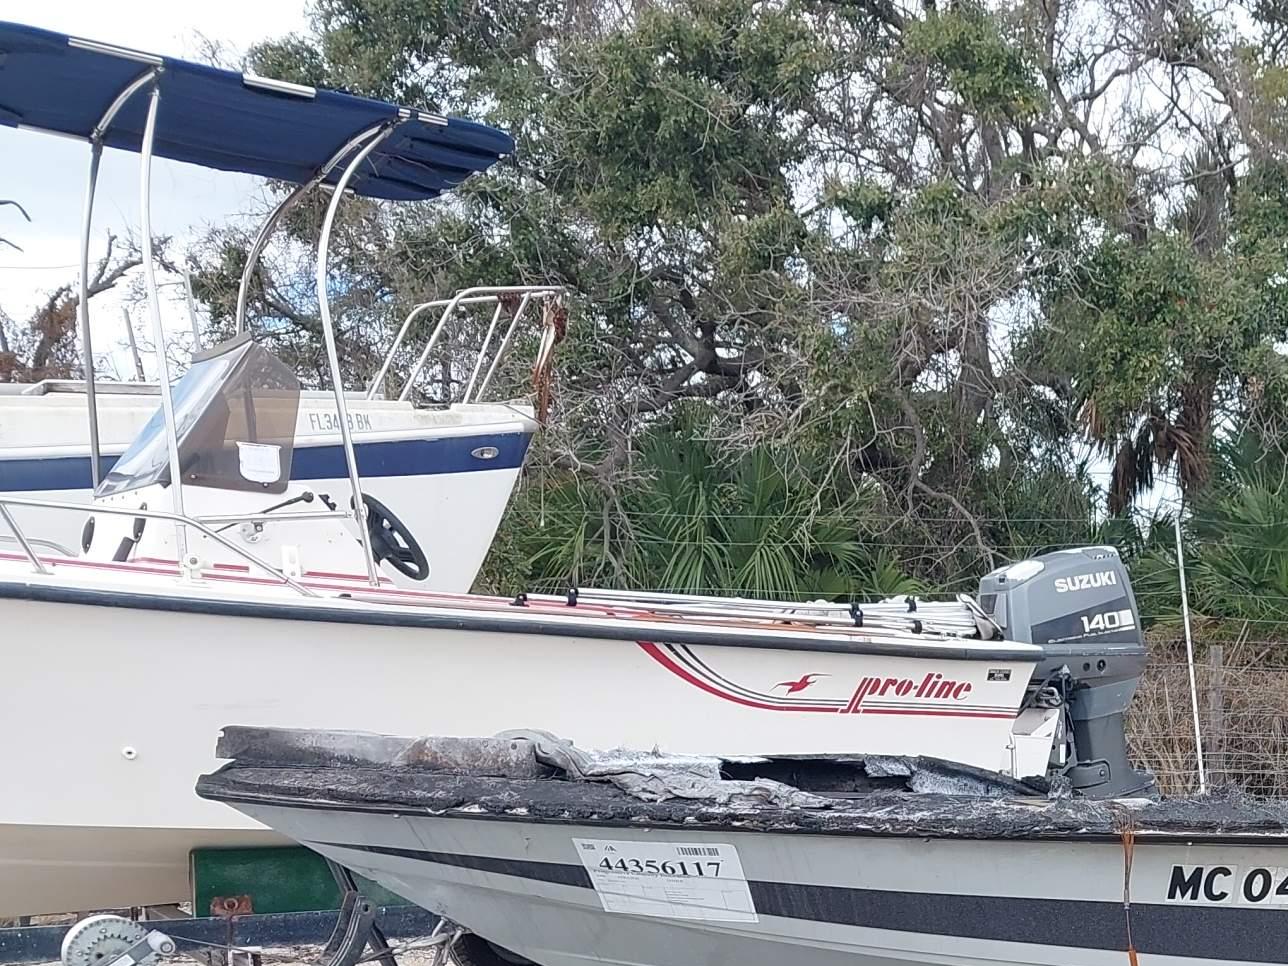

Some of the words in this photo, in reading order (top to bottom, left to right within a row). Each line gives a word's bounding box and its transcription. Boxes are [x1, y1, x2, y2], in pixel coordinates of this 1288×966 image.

[1054, 570, 1117, 593] SUZUKI
[1081, 611, 1120, 633] 140
[839, 672, 973, 714] pro-line
[599, 856, 722, 878] 44356117
[1166, 865, 1233, 901] MC
